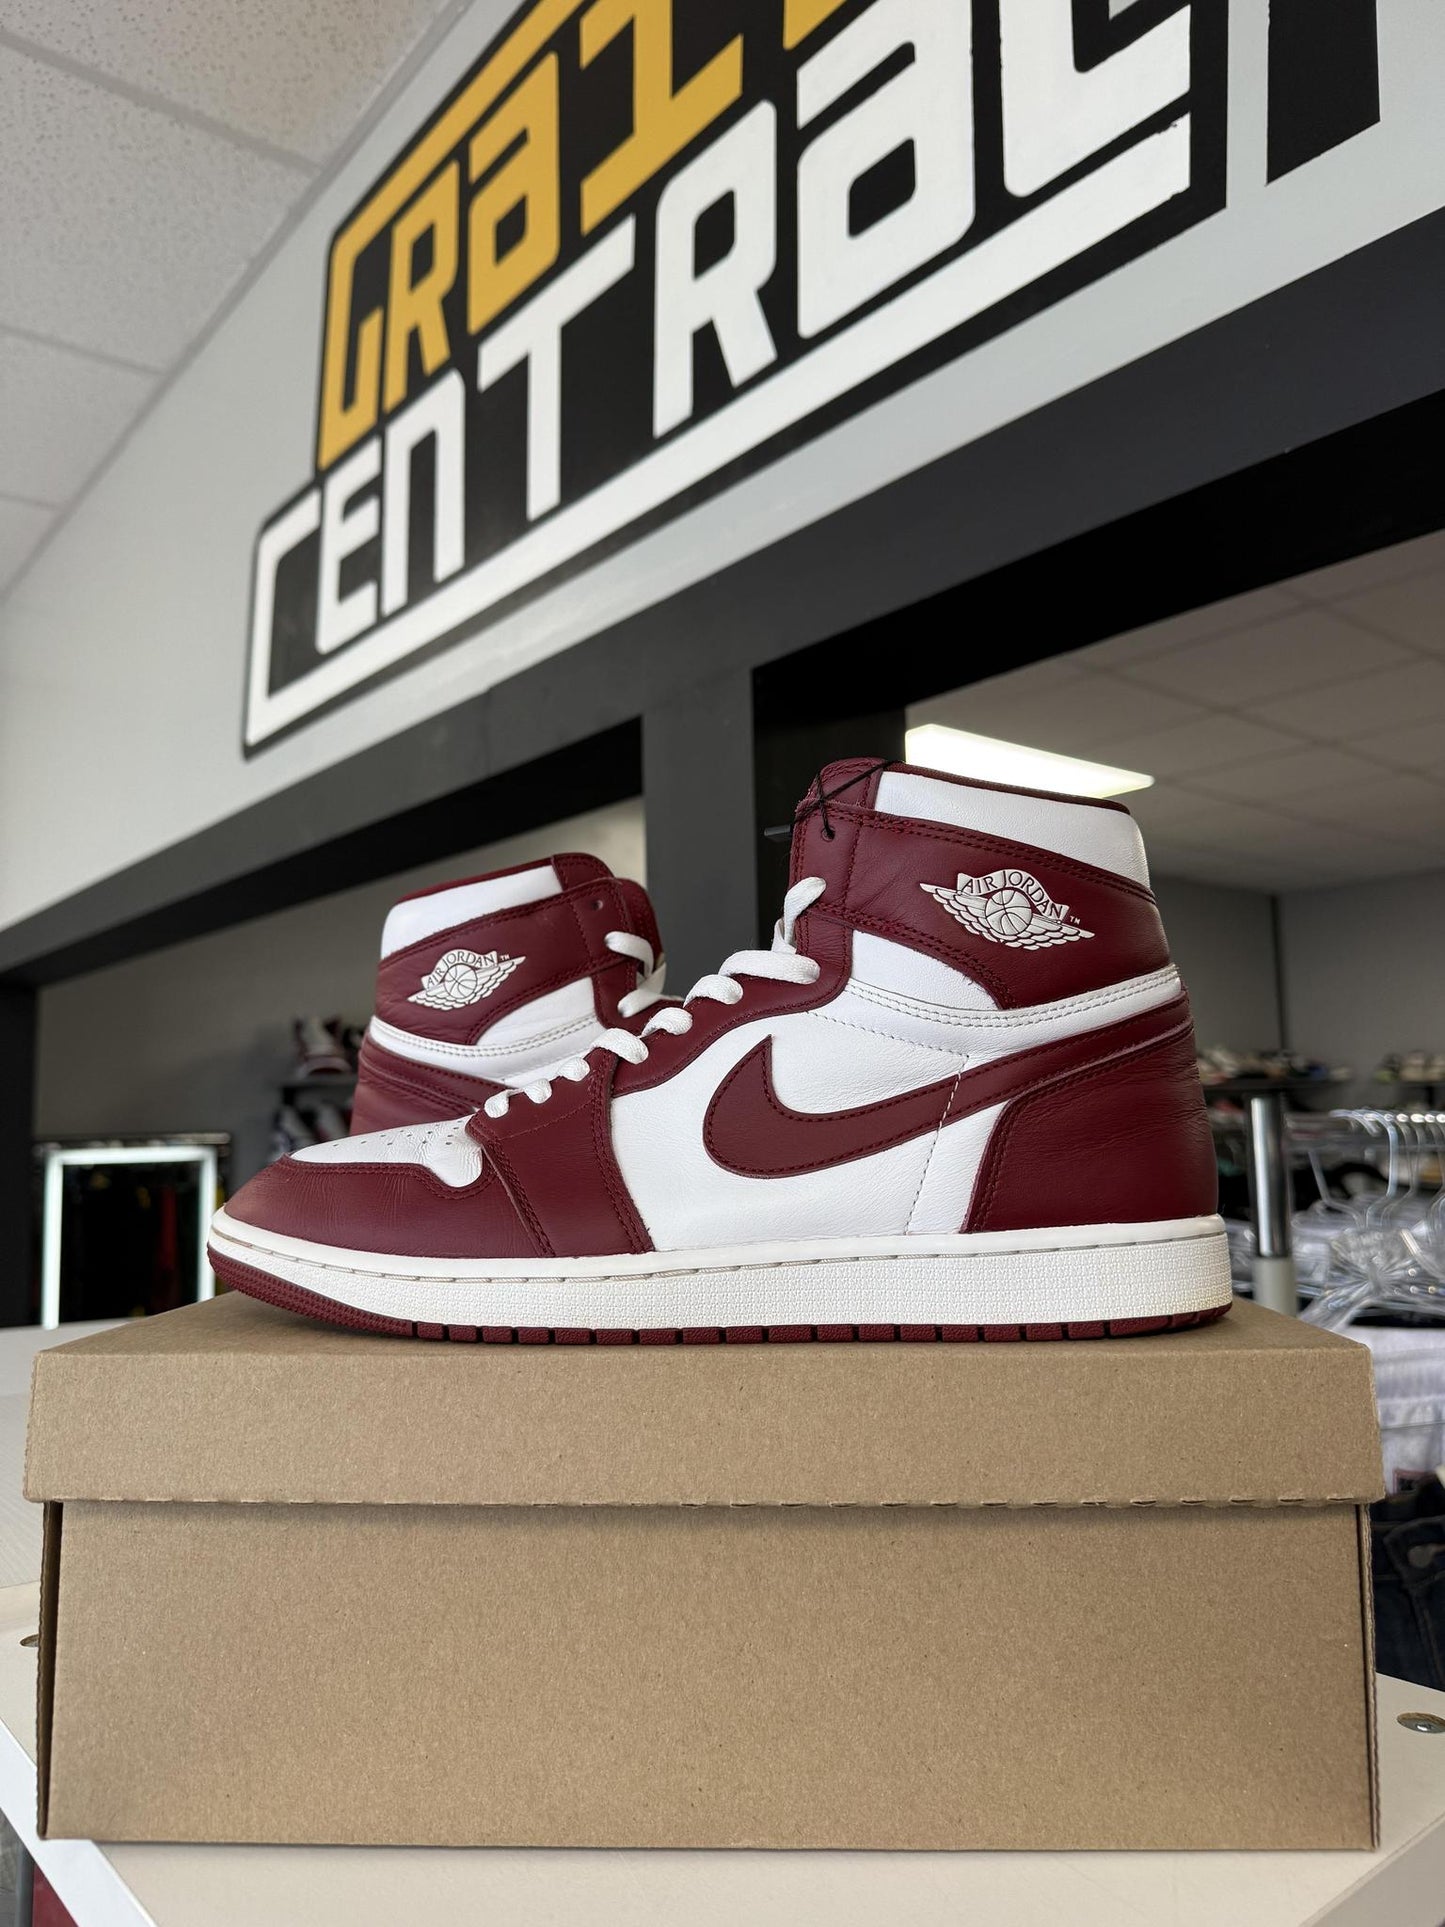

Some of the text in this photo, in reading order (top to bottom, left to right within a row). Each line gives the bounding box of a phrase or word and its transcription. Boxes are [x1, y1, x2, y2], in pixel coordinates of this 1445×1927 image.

[962, 876, 998, 893] AIR
[1002, 871, 1062, 918] JORDAN
[427, 967, 445, 988] AIR
[442, 951, 494, 968] JORDAN
